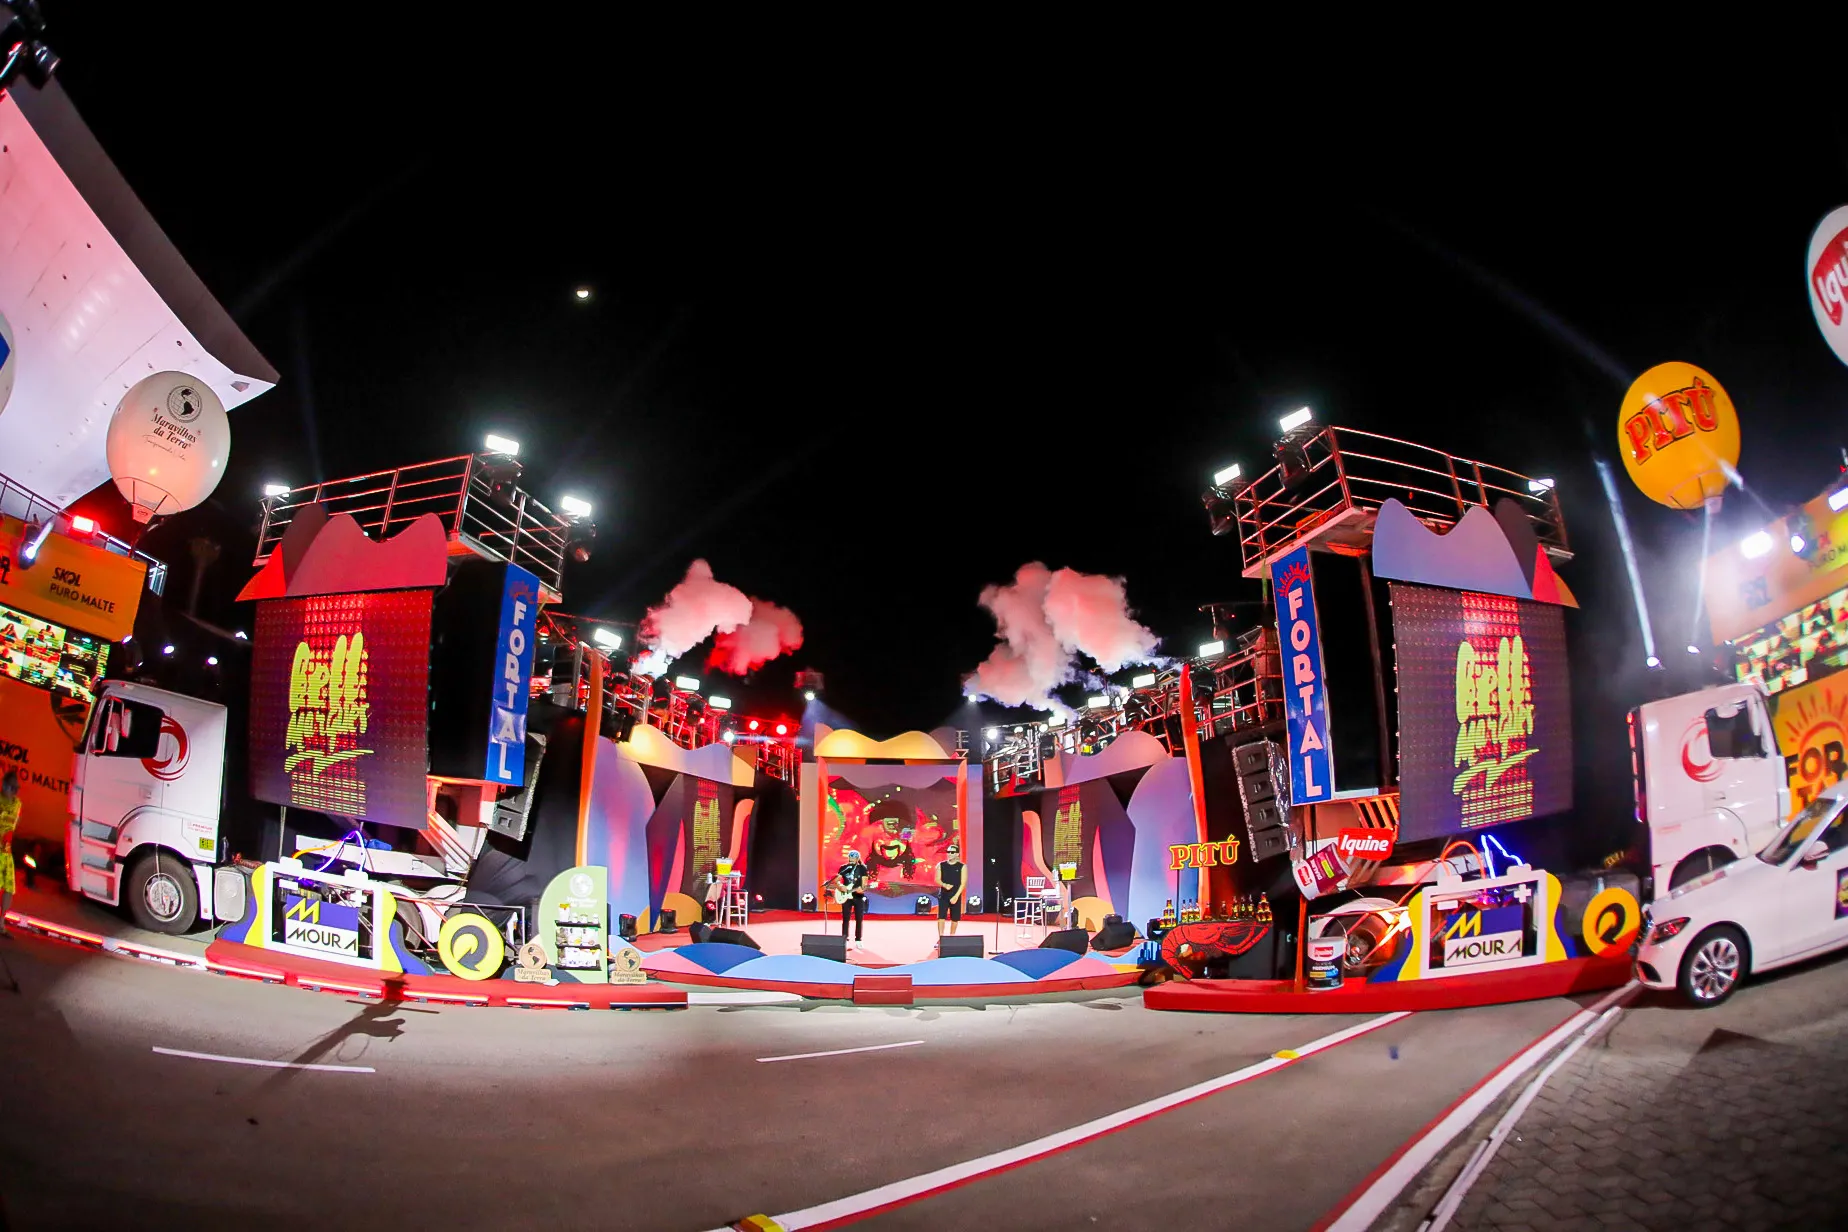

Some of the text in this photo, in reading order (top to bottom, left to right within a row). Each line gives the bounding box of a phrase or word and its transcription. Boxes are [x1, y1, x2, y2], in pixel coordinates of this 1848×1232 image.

[151, 414, 197, 443] Maravilhas
[153, 426, 164, 437] da
[1625, 376, 1718, 465] PITÚ
[52, 567, 81, 586] SKOL
[49, 583, 115, 613] PURO MALTE
[498, 601, 527, 780] FORTAL
[1288, 587, 1325, 798] FORTAL
[1169, 834, 1240, 870] PITÚ
[1341, 835, 1389, 855] Iquine
[287, 928, 357, 952] MOURA
[1447, 938, 1522, 961] MOURA
